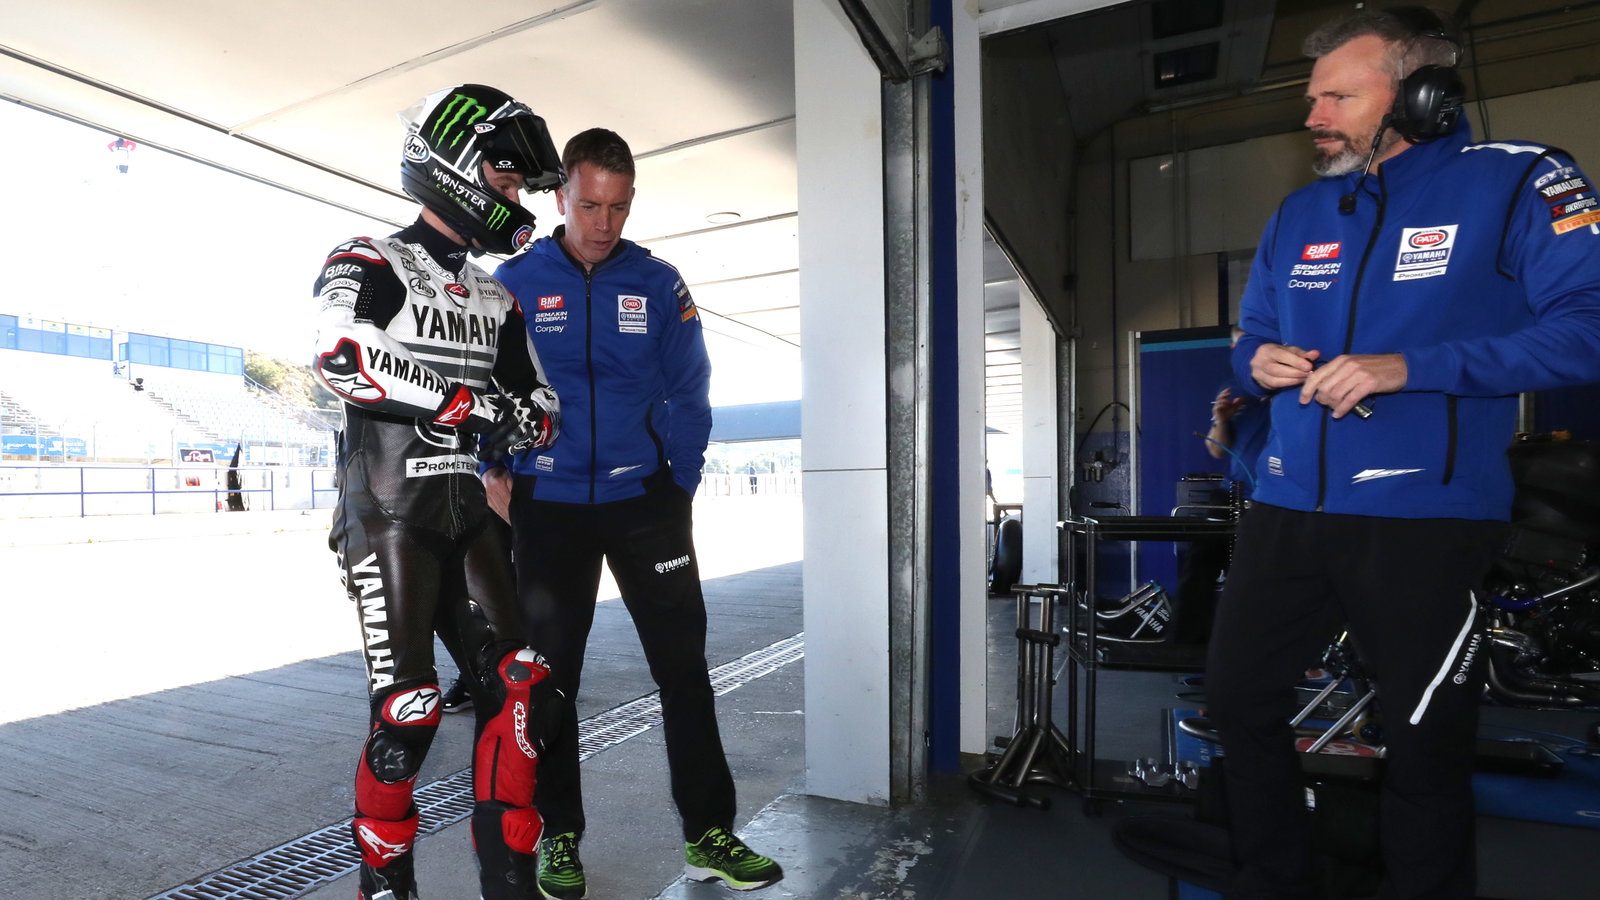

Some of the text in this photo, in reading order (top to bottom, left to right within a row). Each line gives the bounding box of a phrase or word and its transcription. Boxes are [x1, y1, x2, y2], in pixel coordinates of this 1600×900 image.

[432, 168, 487, 211] MONSTER
[1541, 177, 1586, 197] YAMALUBE
[1416, 235, 1440, 244] PATA
[1306, 243, 1339, 255] BMP
[1413, 250, 1446, 260] YAMAHA
[325, 263, 362, 279] BMP
[1293, 262, 1342, 270] SEMAKIN
[1288, 279, 1332, 290] Corpay
[541, 296, 562, 306] BMP
[412, 304, 498, 349] YAMAH
[535, 325, 564, 333] Corpay
[366, 346, 447, 396] YAMAHA
[411, 461, 475, 473] PROMETE
[663, 554, 691, 570] YAMAHA
[352, 552, 394, 692] YAMAHA
[1459, 633, 1482, 672] YAMAHA
